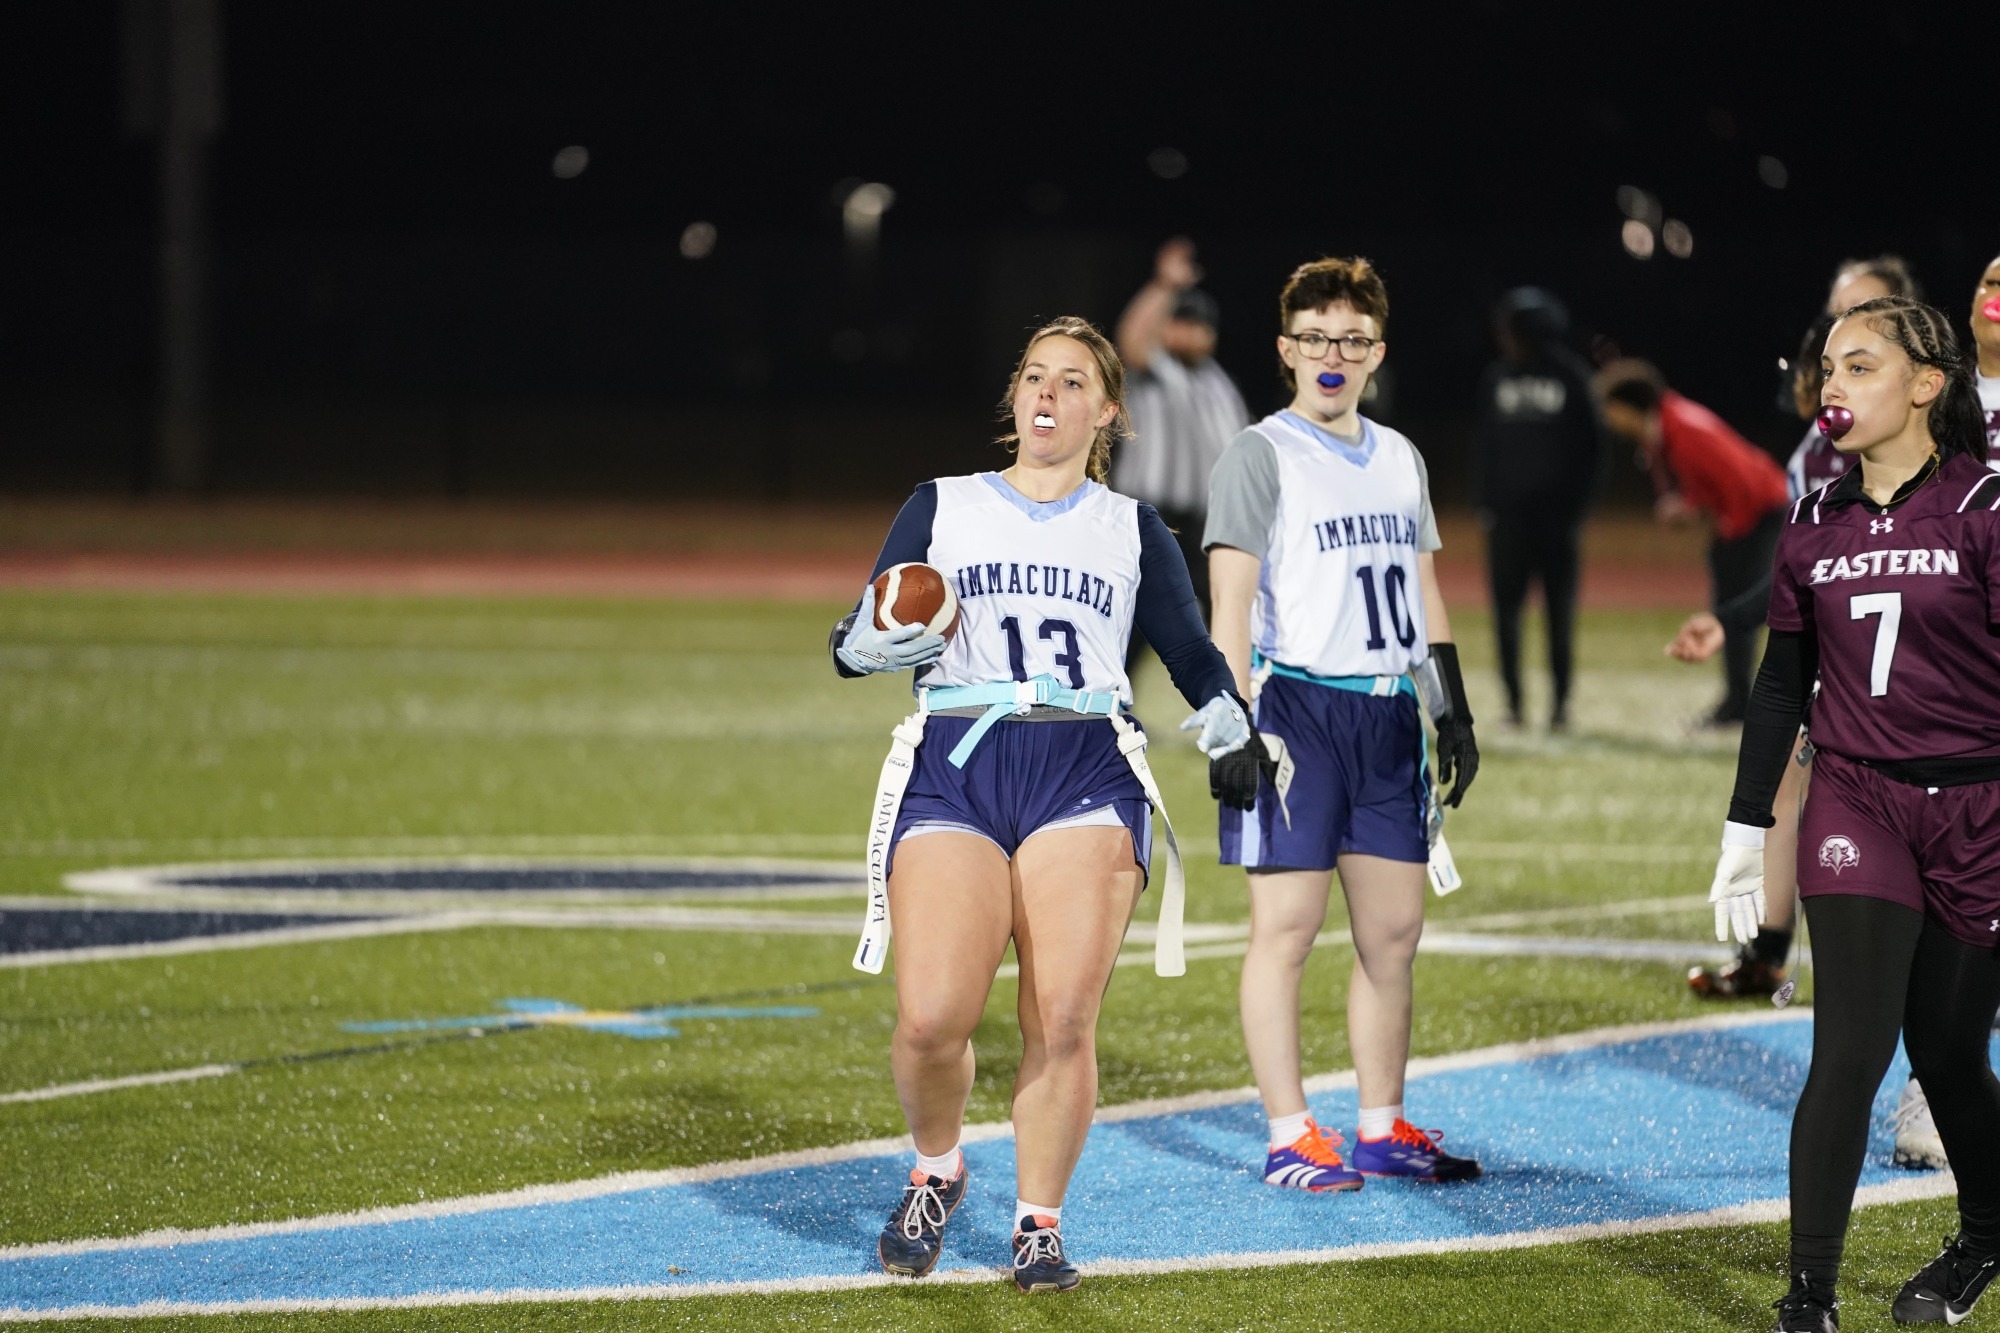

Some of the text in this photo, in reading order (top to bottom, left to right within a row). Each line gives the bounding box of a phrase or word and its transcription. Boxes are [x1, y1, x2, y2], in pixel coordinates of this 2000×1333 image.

[957, 562, 1114, 618] IMMACULATA
[1809, 549, 1960, 585] EASTERN
[1356, 564, 1416, 651] 10
[1850, 592, 1902, 697] 7
[1000, 616, 1086, 690] 13
[872, 791, 896, 924] IMMACULATA
